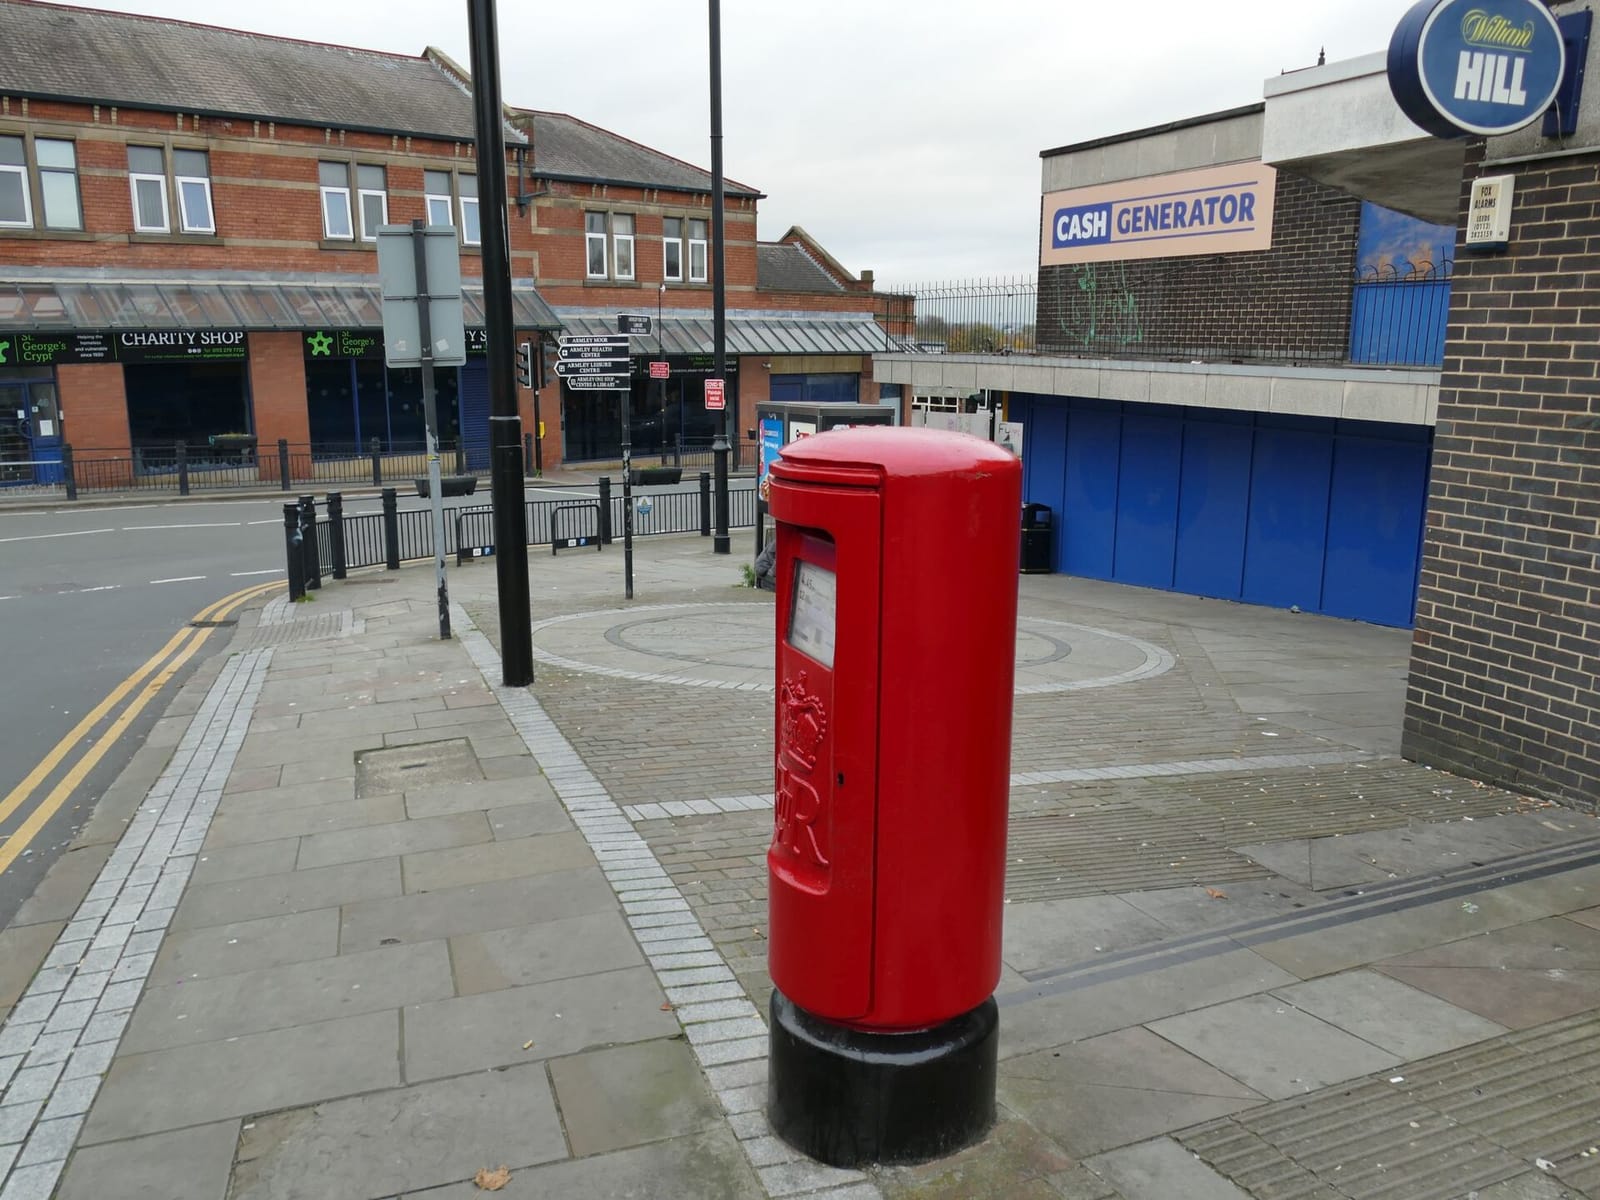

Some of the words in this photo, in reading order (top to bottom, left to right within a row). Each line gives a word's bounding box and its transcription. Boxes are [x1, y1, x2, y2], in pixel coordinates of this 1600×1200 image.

[1462, 8, 1535, 50] William
[1454, 50, 1527, 107] HILL
[1481, 186, 1492, 197] FOX
[1474, 198, 1497, 209] ALARMS
[1056, 210, 1107, 242] CASH
[1117, 192, 1256, 235] GENERATOR
[121, 332, 196, 346] CHARITY
[200, 331, 244, 345] SHOP
[342, 338, 375, 347] George's
[22, 341, 67, 352] George's
[342, 346, 365, 356] Crypt
[23, 352, 53, 362] Crypt
